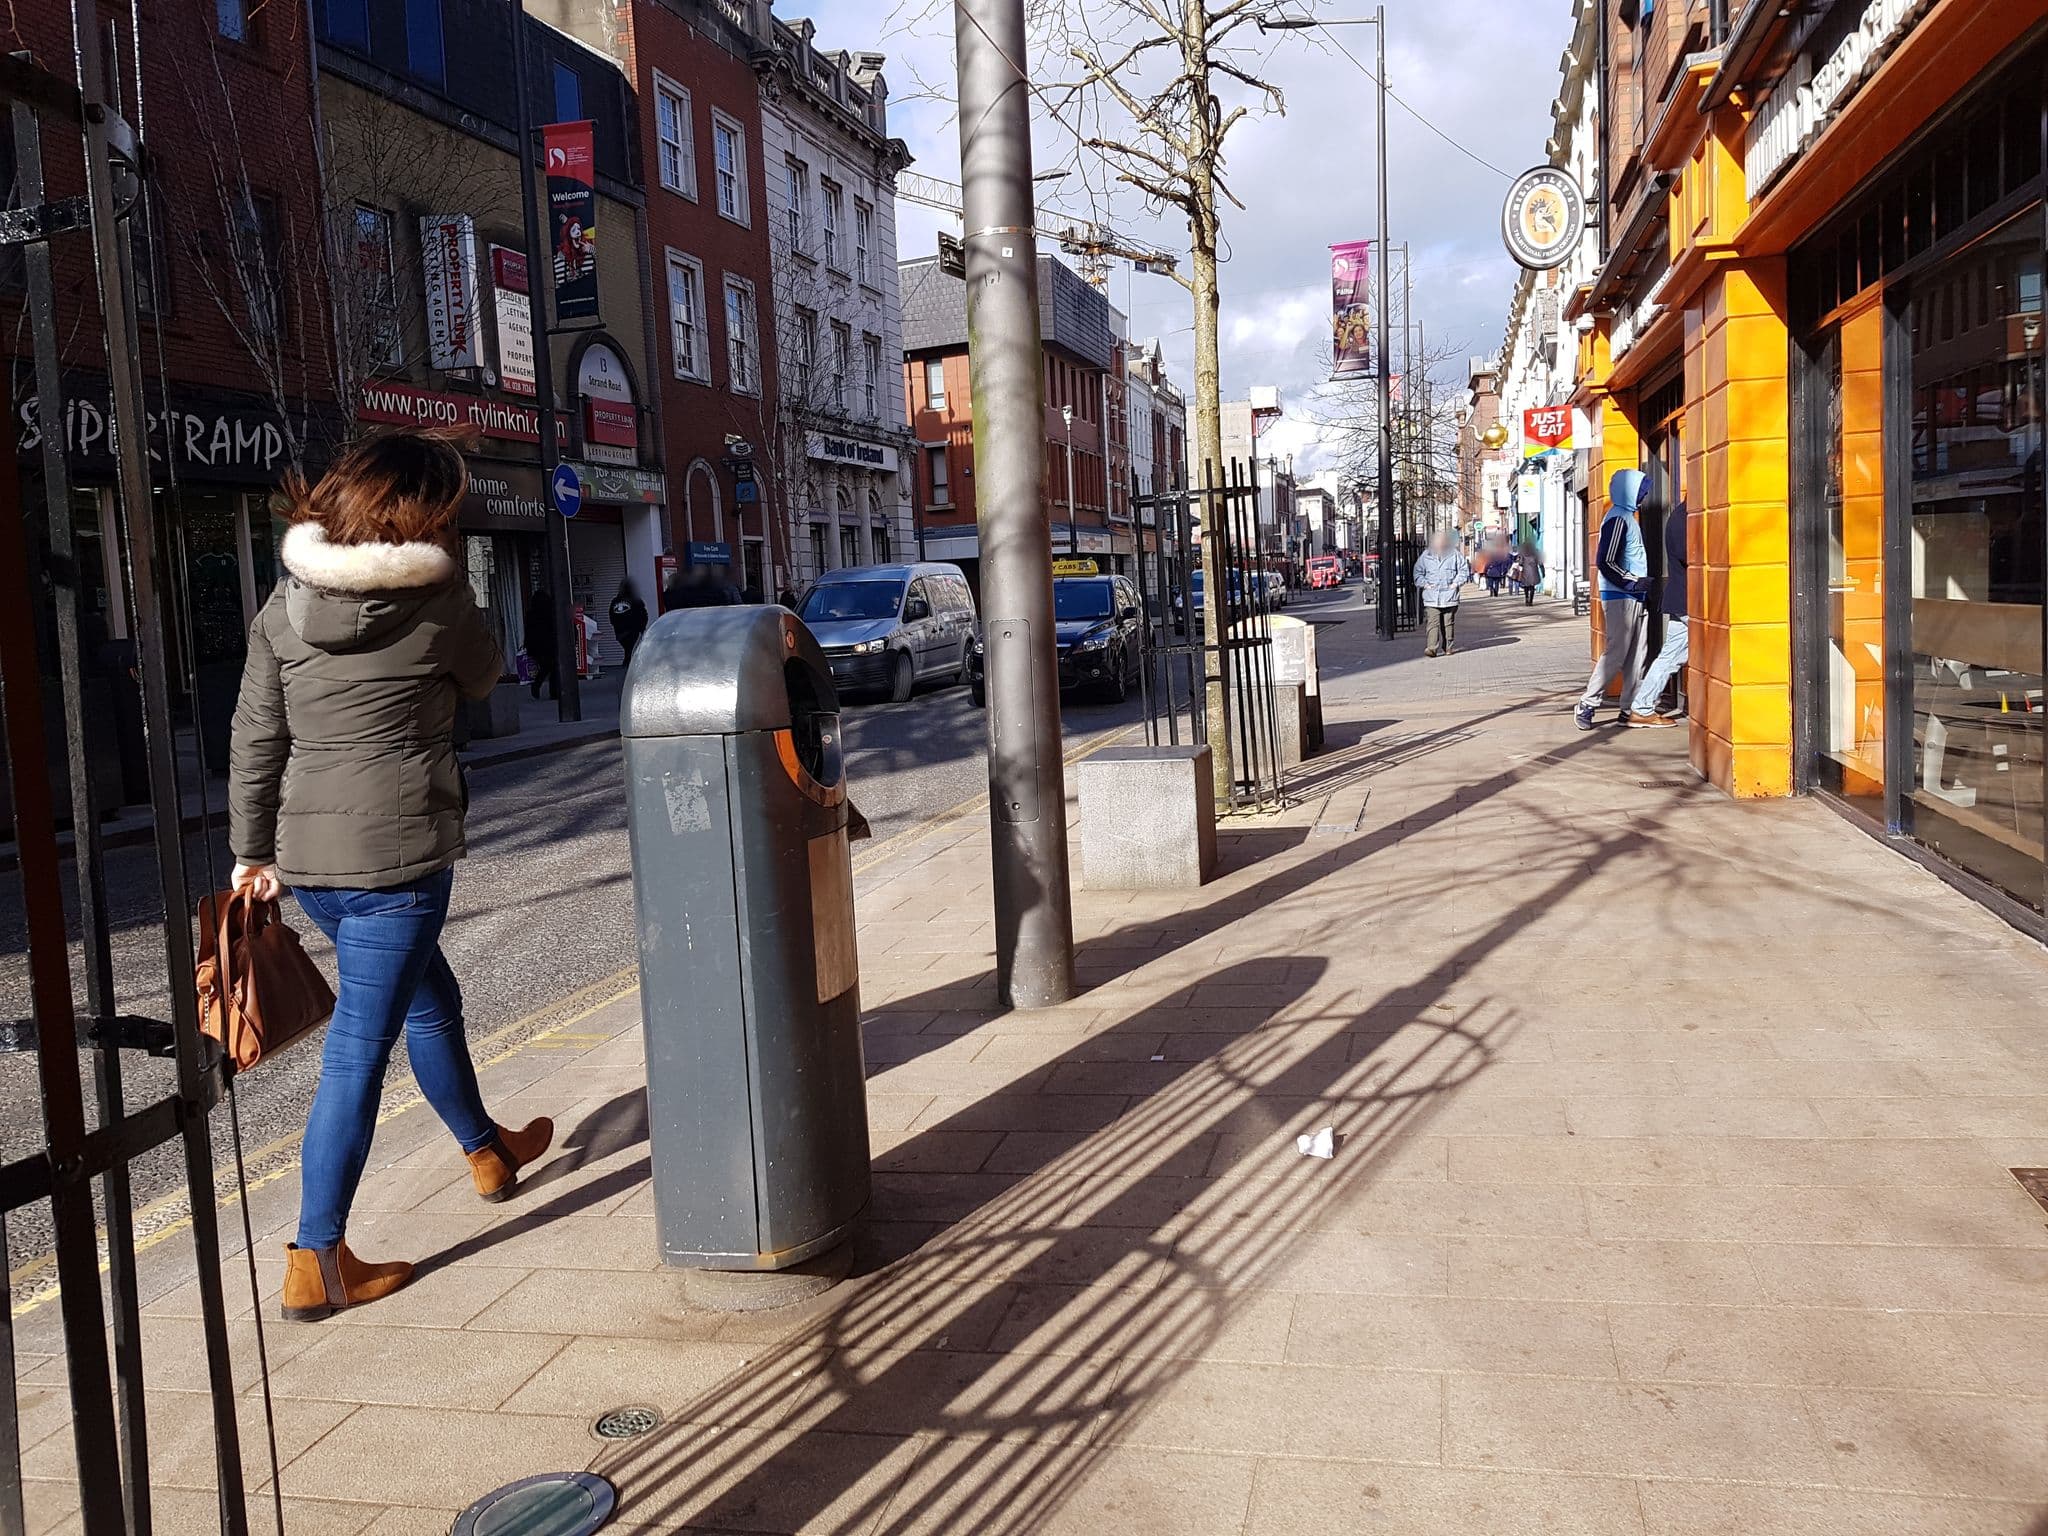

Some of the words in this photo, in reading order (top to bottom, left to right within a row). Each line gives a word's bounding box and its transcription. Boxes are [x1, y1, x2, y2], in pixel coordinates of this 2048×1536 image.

[552, 190, 590, 202] Welcome
[440, 223, 464, 310] PROPERTY
[506, 306, 530, 321] LETTING
[450, 314, 468, 354] LINK
[515, 338, 526, 348] AND
[507, 350, 532, 364] PROPERT
[599, 356, 608, 373] 13
[503, 363, 535, 378] MANAGEME
[588, 374, 607, 389] Strand
[608, 377, 622, 392] Road
[594, 409, 621, 423] PROPERTY
[1530, 410, 1566, 428] JUST
[1537, 422, 1566, 438] EAT
[824, 435, 847, 458] Bank
[847, 438, 857, 459] of
[857, 441, 884, 465] Ireland
[594, 466, 609, 479] TOP
[468, 471, 508, 497] home
[486, 494, 546, 518] comforts
